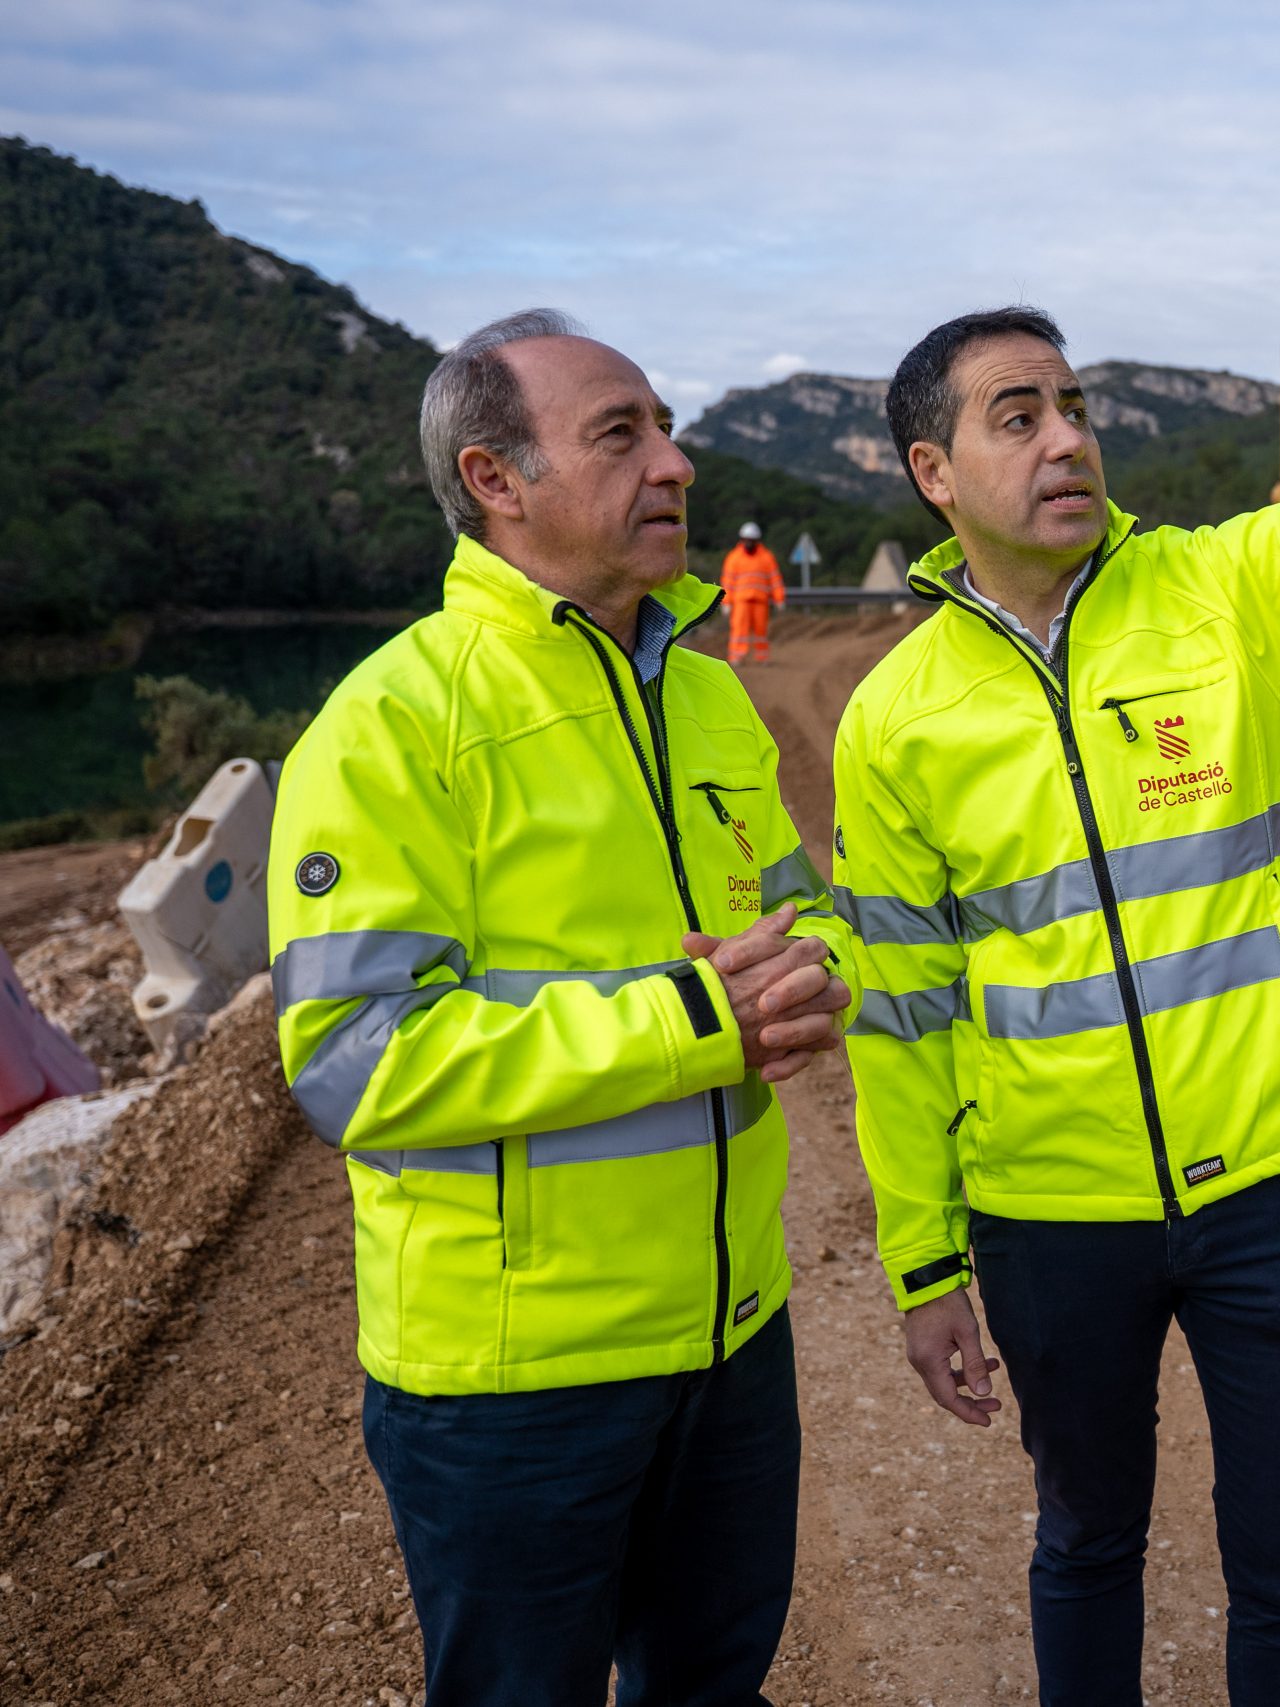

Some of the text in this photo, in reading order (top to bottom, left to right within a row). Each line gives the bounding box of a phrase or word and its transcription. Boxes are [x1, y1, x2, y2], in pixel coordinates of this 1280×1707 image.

[1138, 761, 1224, 794] Diputació
[1138, 777, 1233, 812] de Castelló
[727, 874, 760, 896] Diputa
[742, 895, 760, 912] Cas
[1186, 1158, 1222, 1179] WORKTEAM
